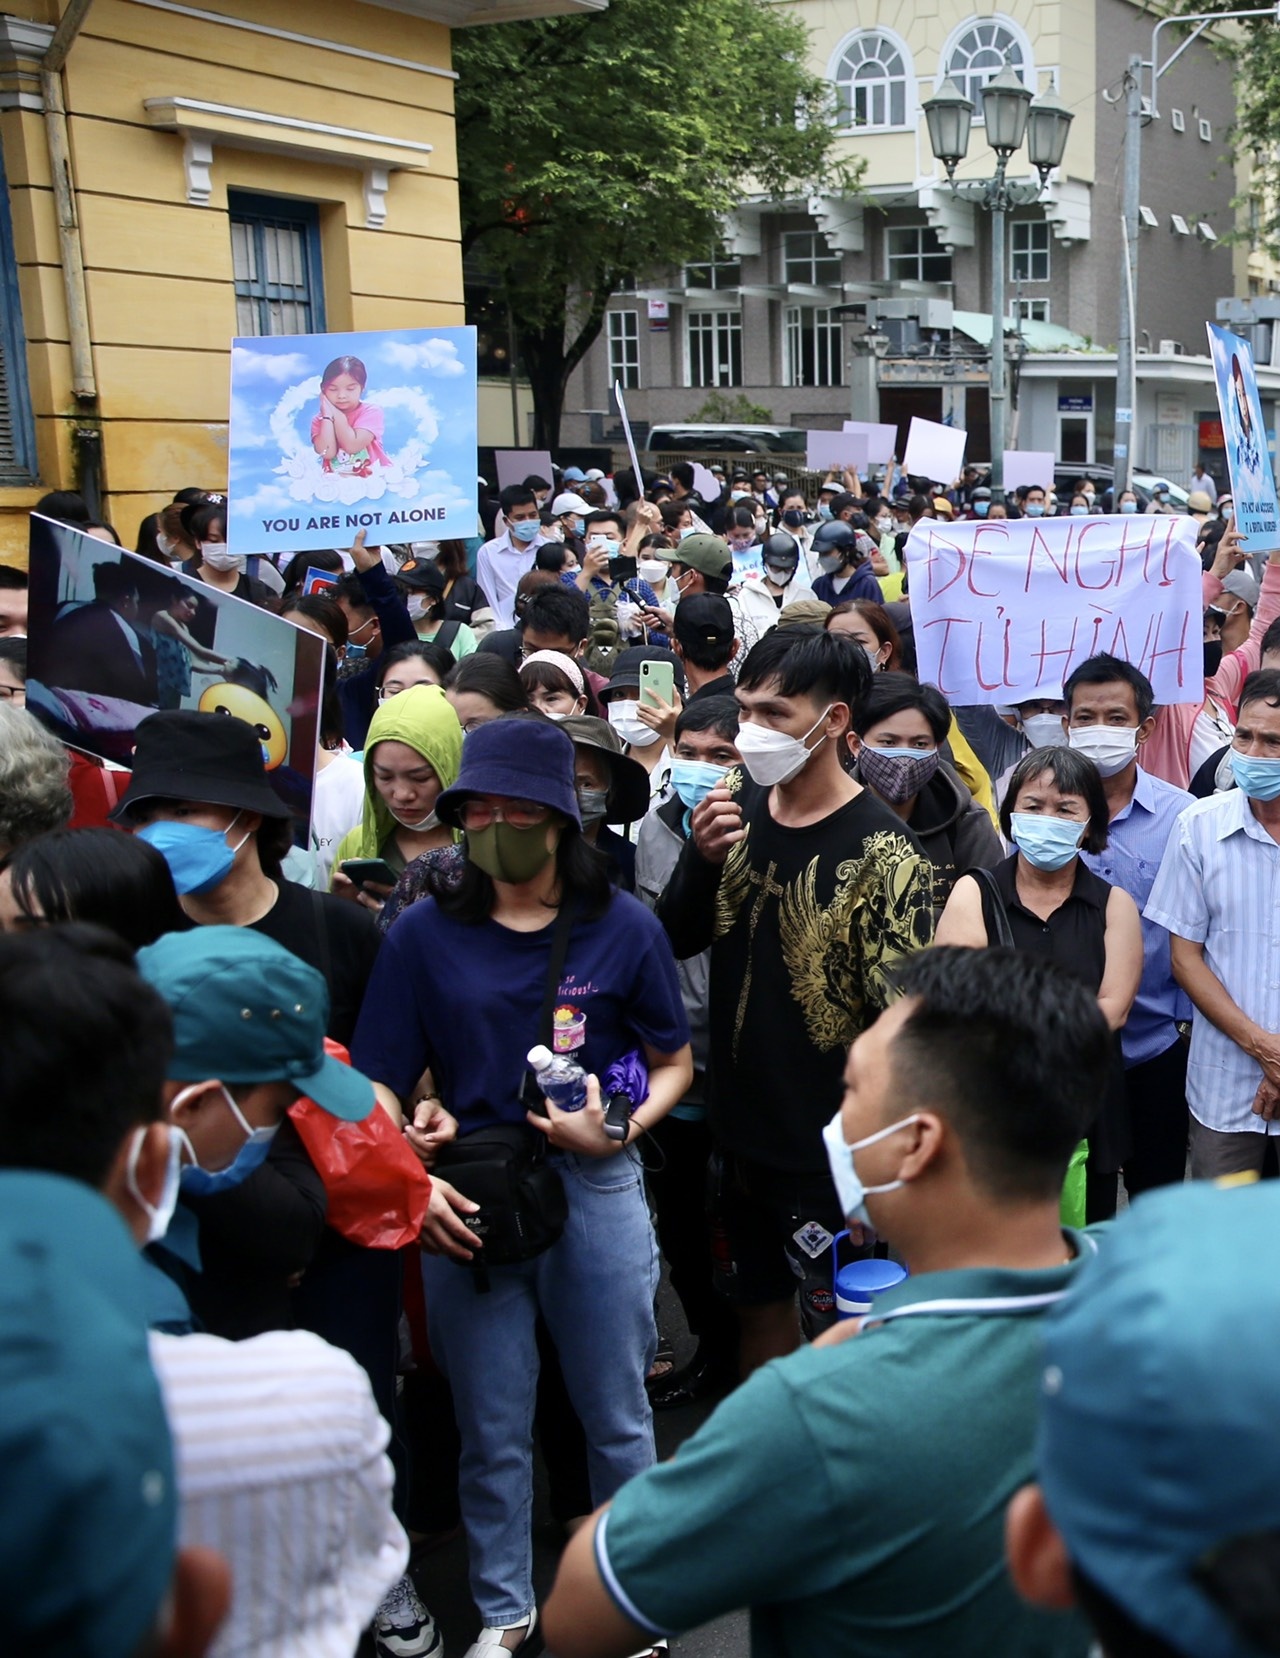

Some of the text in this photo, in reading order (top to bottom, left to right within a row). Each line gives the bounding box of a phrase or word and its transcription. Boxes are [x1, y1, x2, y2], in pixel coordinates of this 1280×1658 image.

[262, 508, 446, 532] YOU ARE NOT ALONE
[1025, 518, 1180, 592] NGHỊ
[319, 837, 333, 846] EY
